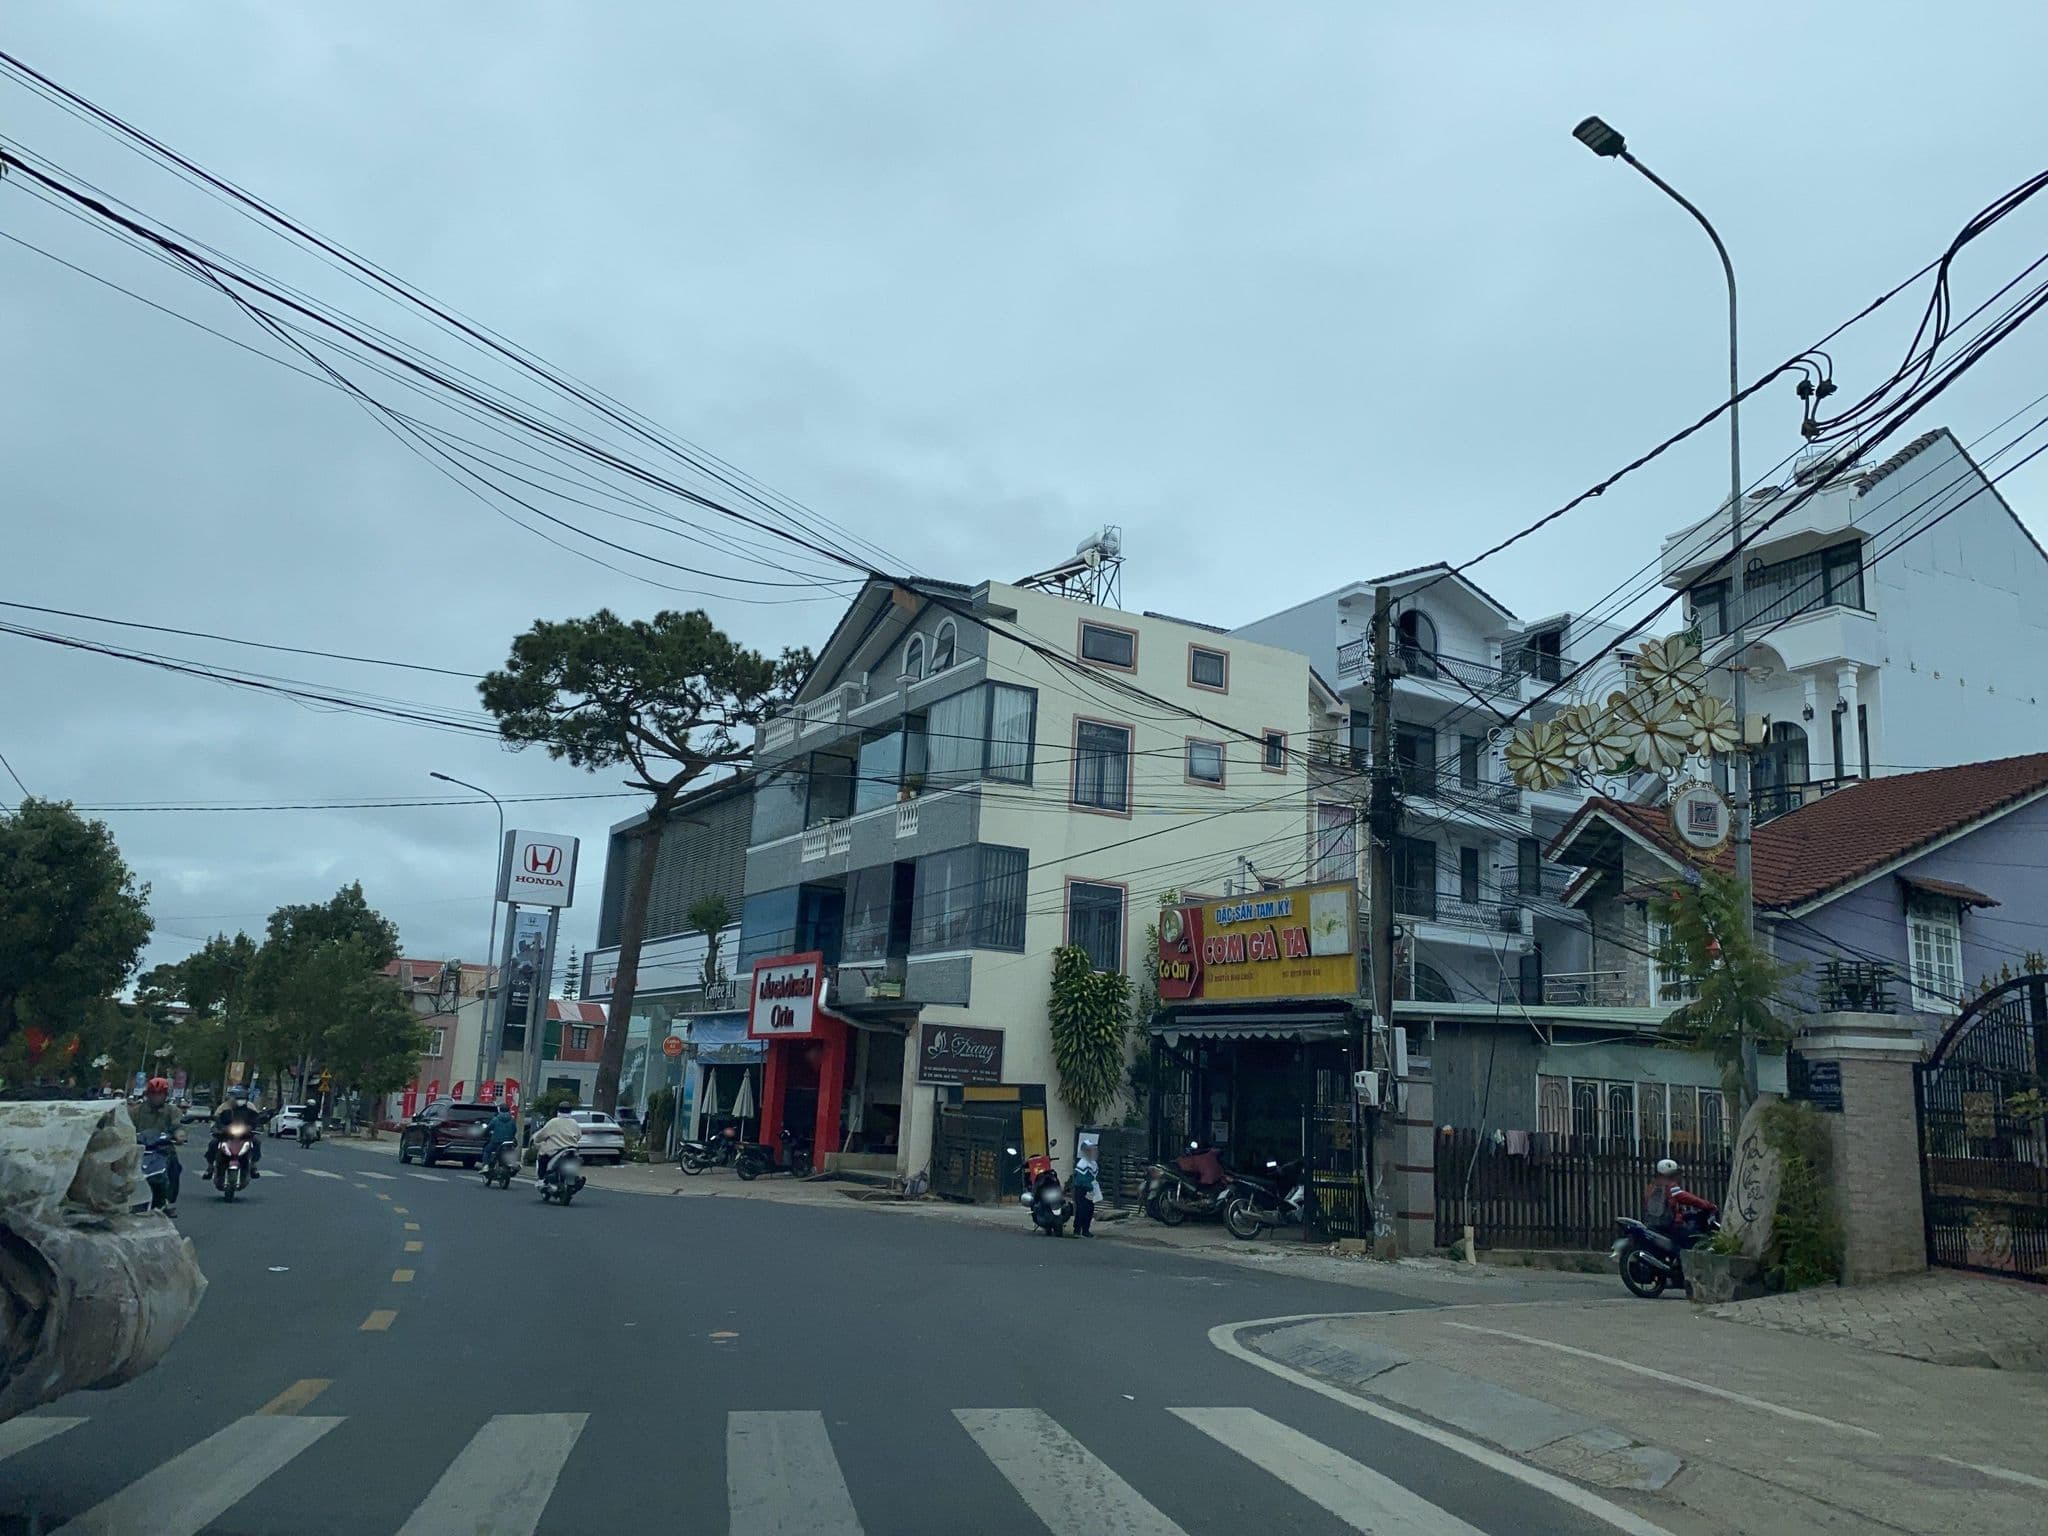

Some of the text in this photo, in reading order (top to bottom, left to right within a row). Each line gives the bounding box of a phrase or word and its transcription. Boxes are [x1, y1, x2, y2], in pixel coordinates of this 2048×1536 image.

[514, 875, 565, 888] HONDA
[1255, 902, 1274, 918] TAM
[1247, 924, 1279, 961] GÀ
[1282, 926, 1309, 958] TA
